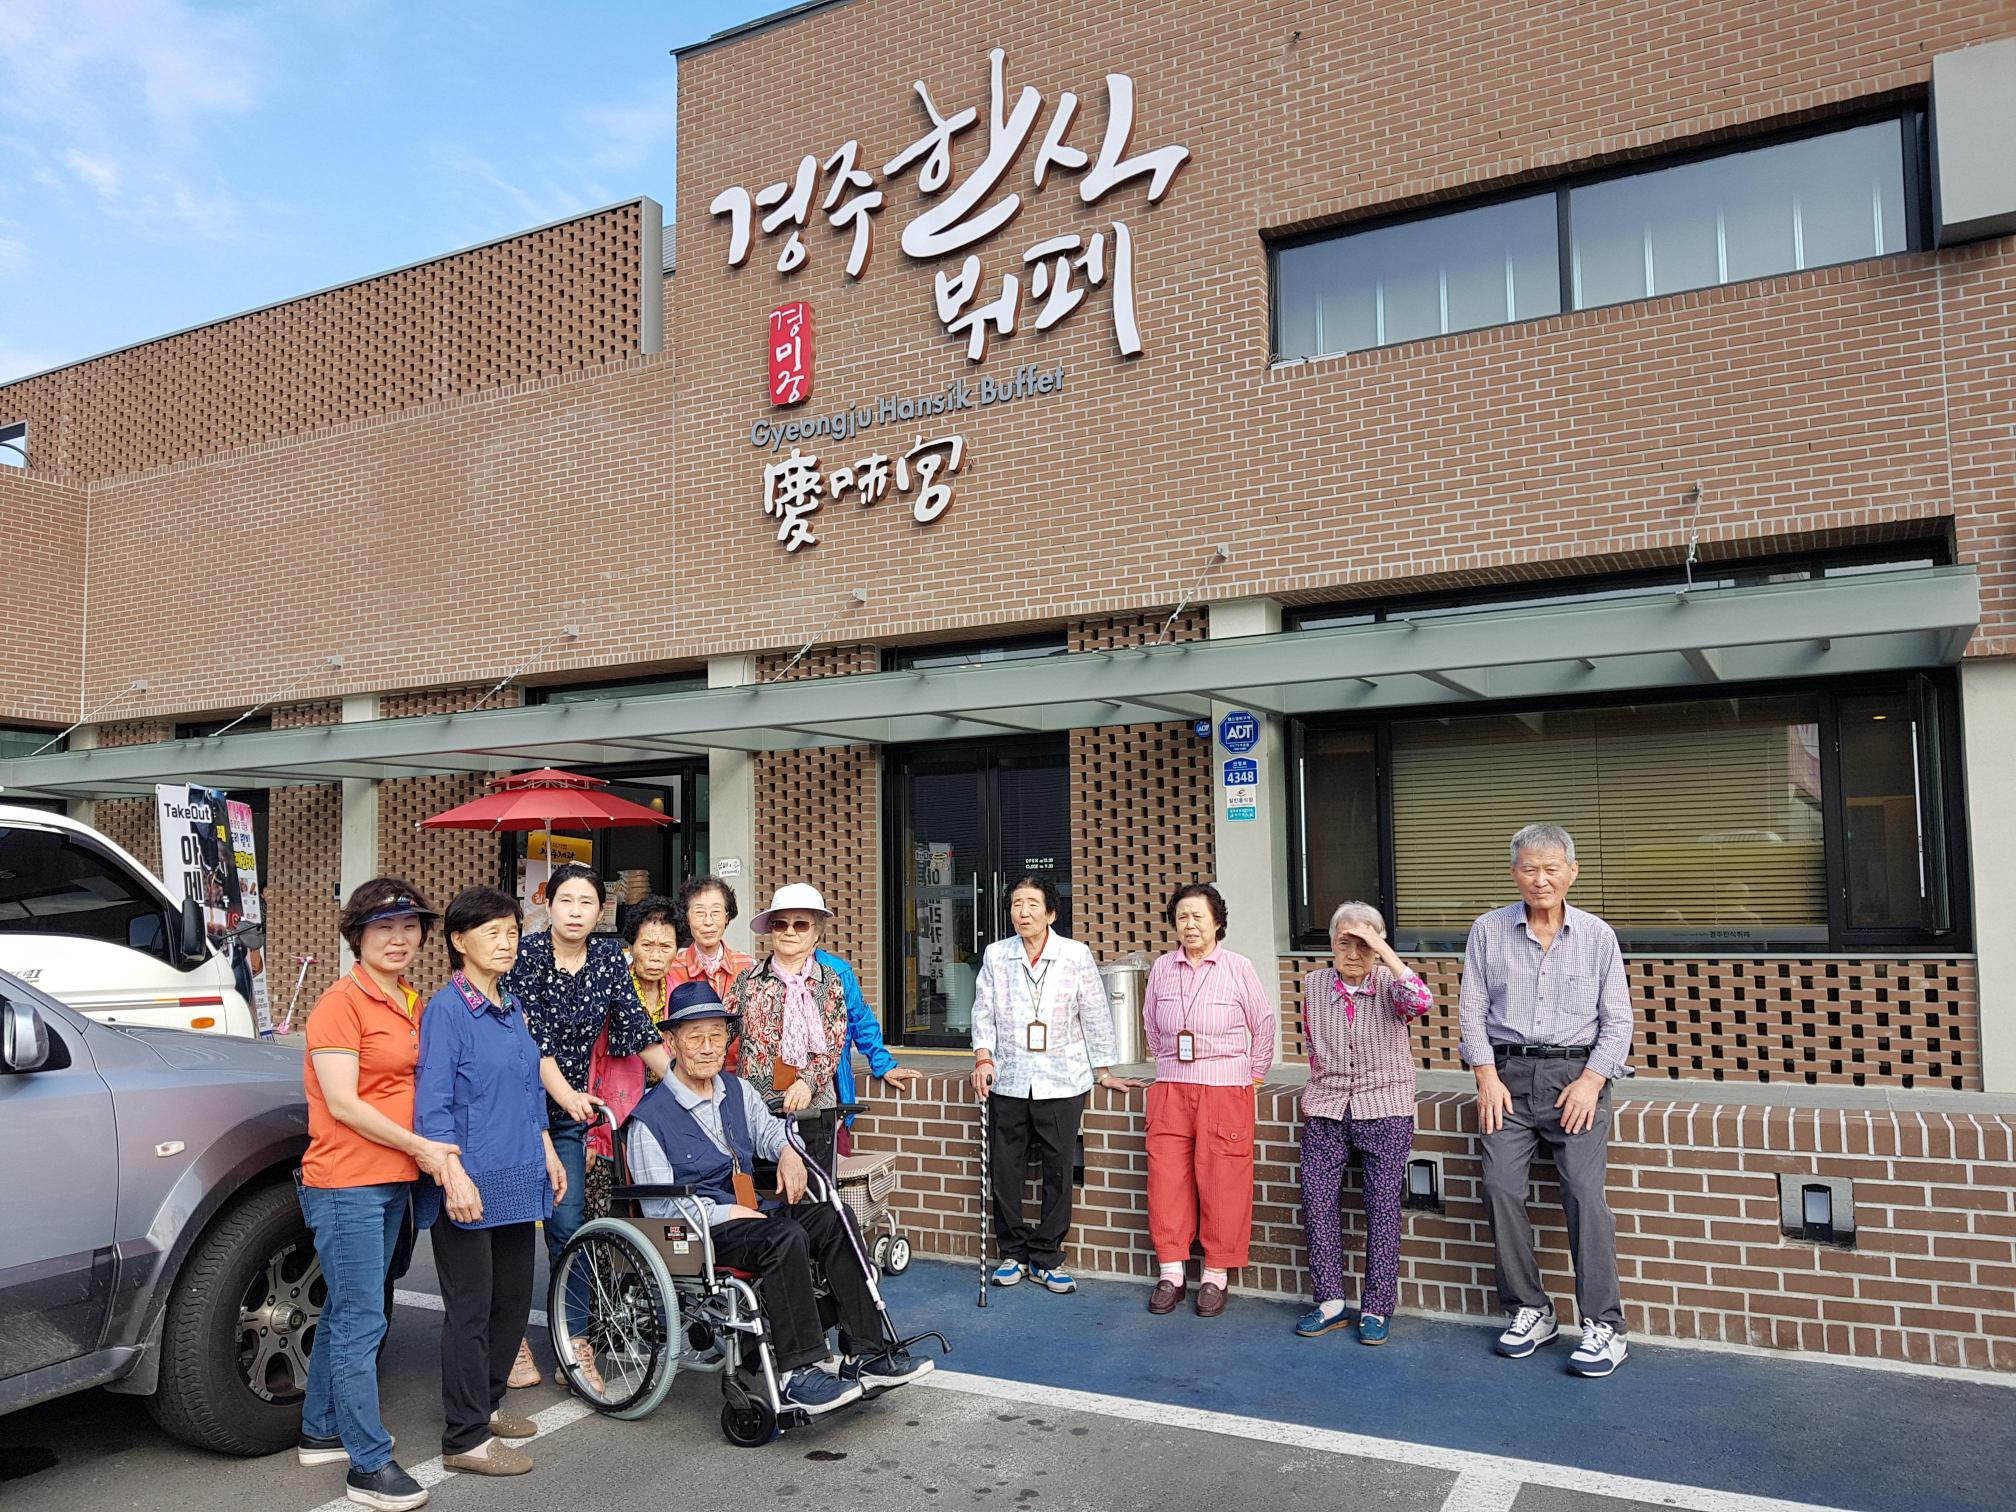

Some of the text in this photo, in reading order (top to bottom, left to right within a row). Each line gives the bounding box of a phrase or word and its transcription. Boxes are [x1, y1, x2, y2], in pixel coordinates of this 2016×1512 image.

[934, 220, 1146, 364] 뷔페
[750, 365, 1066, 451] Gyeongju Hansik Buffet
[1226, 725, 1253, 740] ADT
[1227, 771, 1255, 784] 4348
[163, 801, 211, 821] TakeOut
